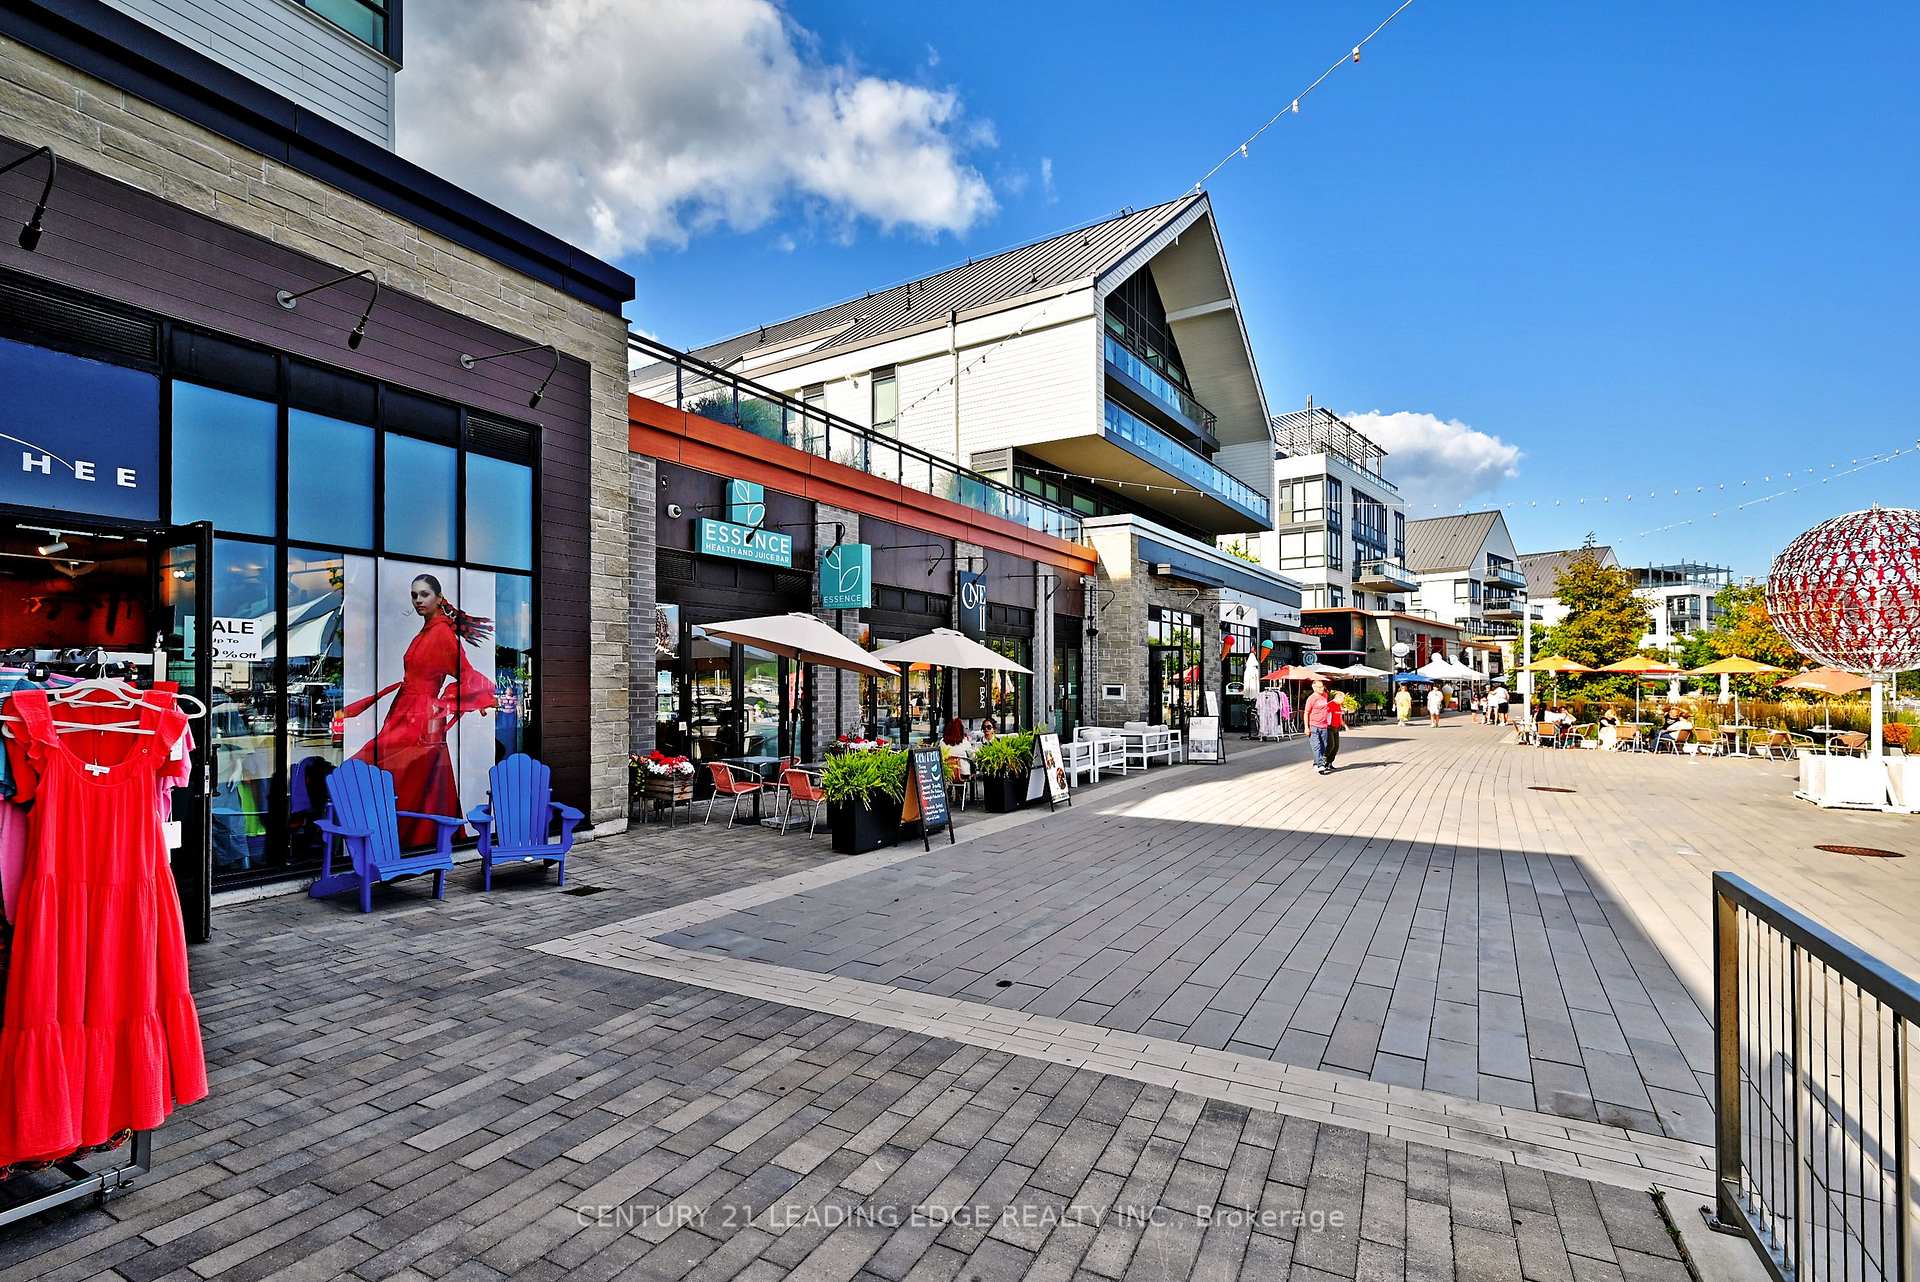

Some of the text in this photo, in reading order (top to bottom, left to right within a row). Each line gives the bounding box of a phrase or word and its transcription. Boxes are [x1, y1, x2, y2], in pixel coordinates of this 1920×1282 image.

[706, 524, 790, 555] ESSENCE
[705, 543, 736, 555] HEALTH
[737, 548, 753, 557] AND
[823, 595, 861, 603] ESSENCE
[212, 620, 254, 634] ALE
